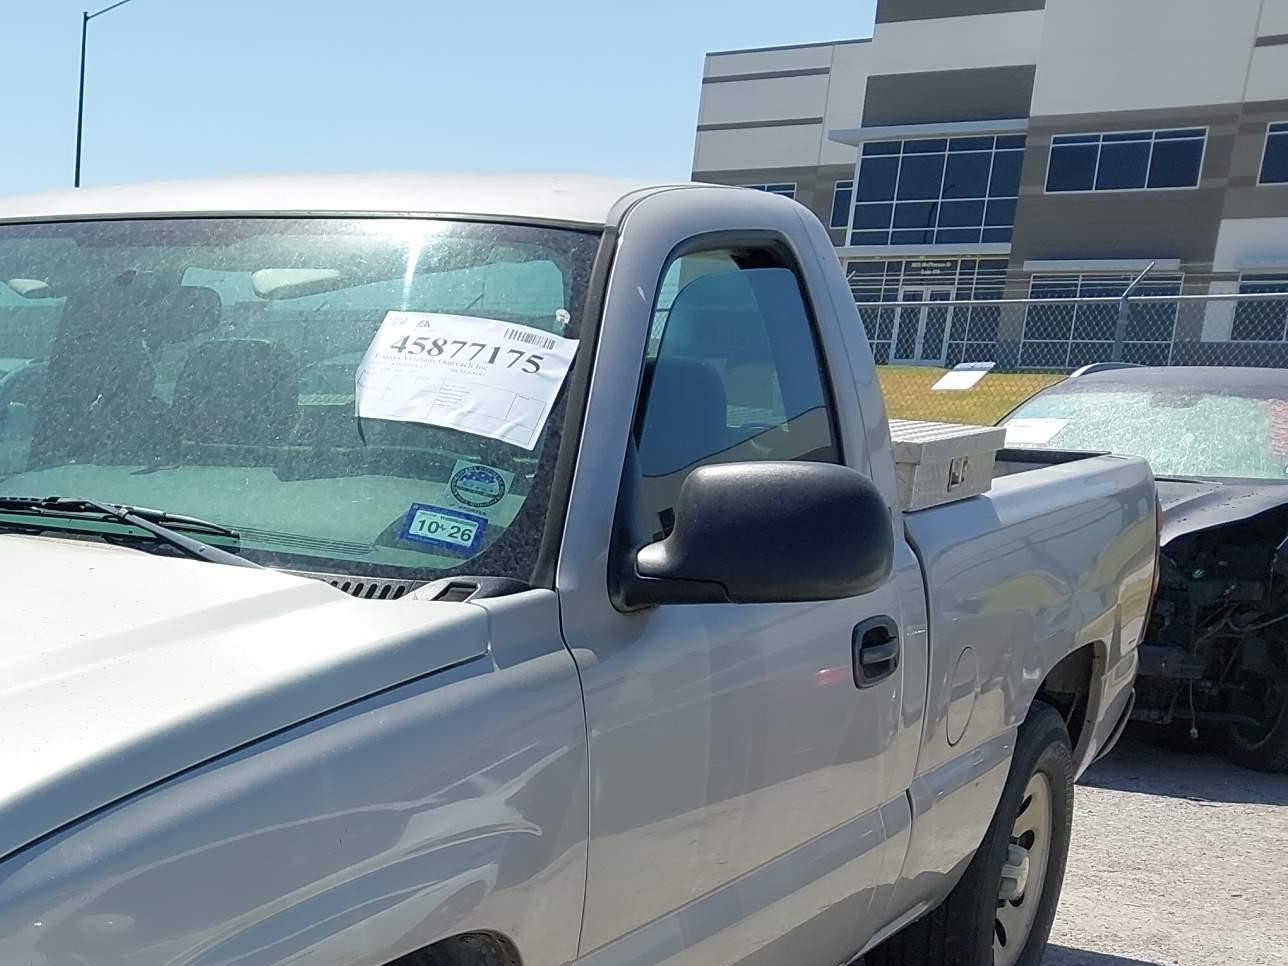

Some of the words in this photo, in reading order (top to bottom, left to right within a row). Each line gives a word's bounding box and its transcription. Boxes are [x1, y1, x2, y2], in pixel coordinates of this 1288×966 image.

[390, 335, 544, 374] 45877175
[418, 519, 440, 534] 10
[447, 525, 473, 542] 26
